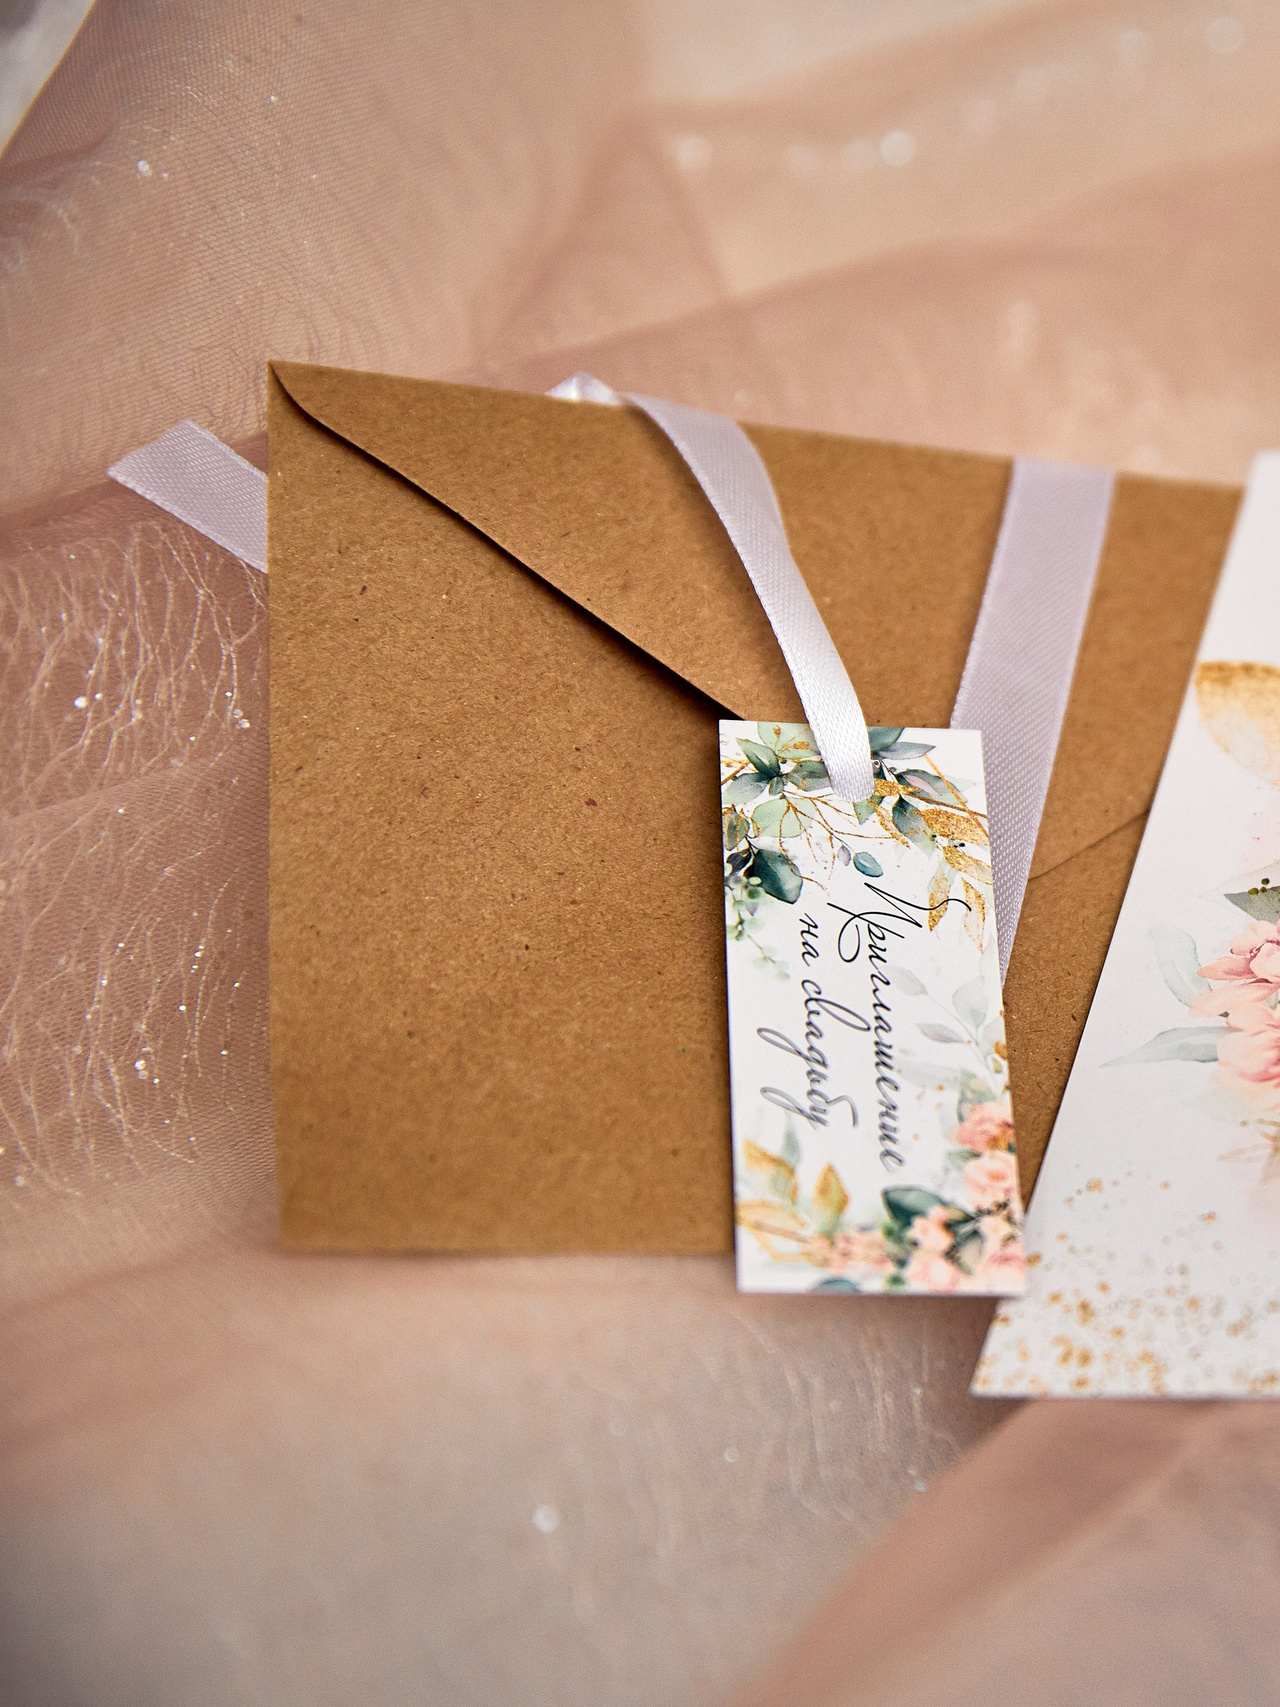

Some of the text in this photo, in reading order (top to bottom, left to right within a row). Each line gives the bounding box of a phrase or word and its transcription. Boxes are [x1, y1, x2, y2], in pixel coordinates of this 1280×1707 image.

[757, 912, 872, 1133] на свадьбу
[826, 881, 972, 1174] Приглашение
